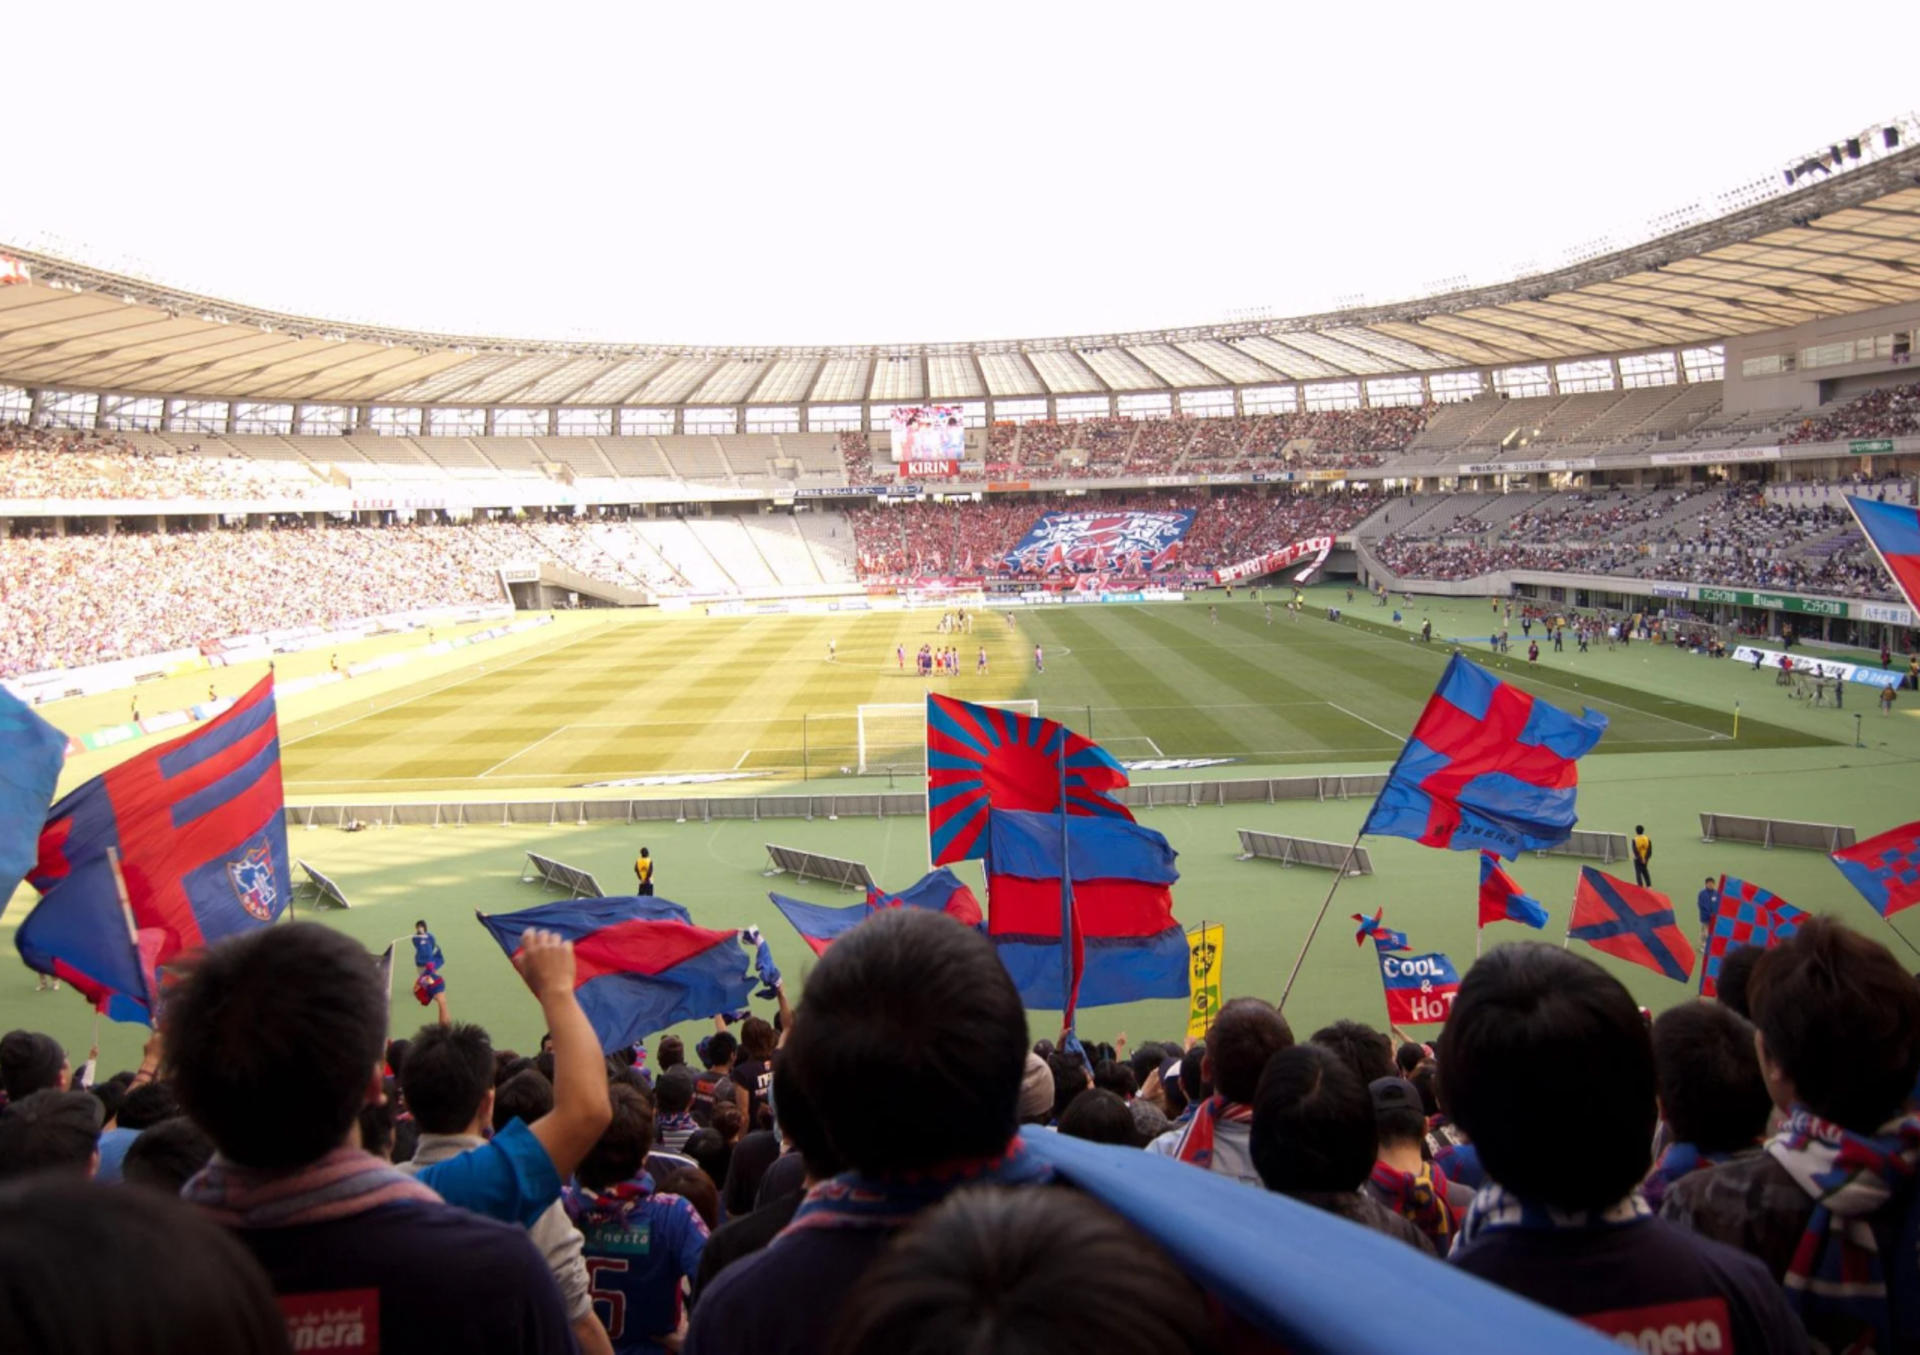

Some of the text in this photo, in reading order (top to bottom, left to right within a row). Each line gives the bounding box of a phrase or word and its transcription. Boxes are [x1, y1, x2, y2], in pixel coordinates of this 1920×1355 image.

[908, 461, 949, 474] KIRIN
[1296, 537, 1331, 556] ZICO
[1421, 979, 1433, 993] &
